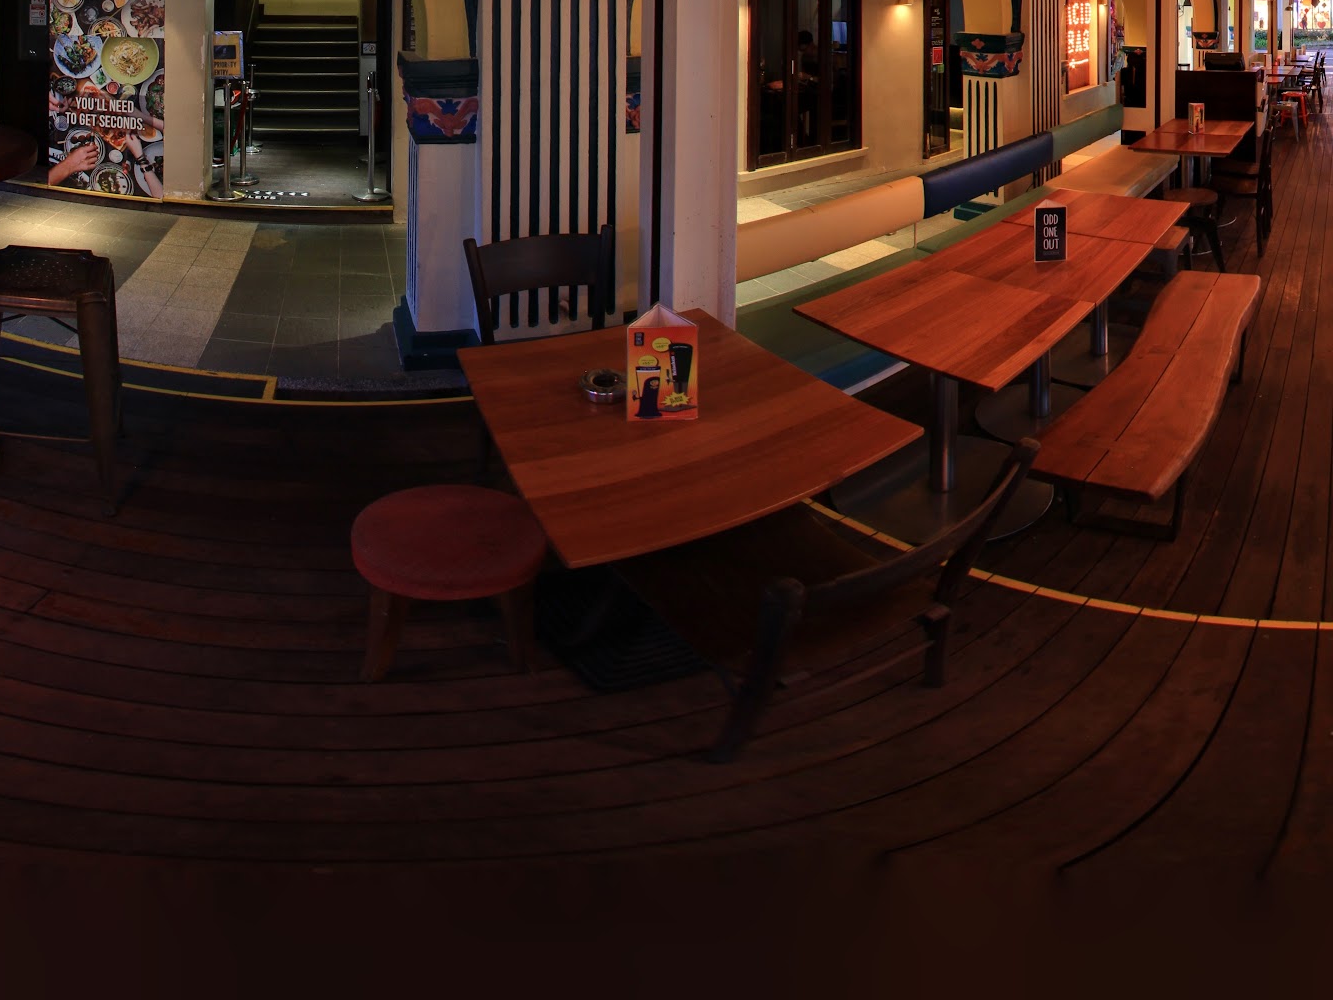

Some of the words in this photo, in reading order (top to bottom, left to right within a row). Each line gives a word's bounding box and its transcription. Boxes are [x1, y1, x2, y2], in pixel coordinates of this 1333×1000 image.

[75, 96, 108, 112] YOU'LL
[109, 99, 134, 113] NEED
[65, 111, 77, 125] TO
[79, 113, 97, 127] GET
[99, 115, 146, 131] SECONDS.
[1043, 213, 1059, 225] ODD
[1043, 226, 1058, 238] ONE
[1043, 238, 1059, 250] OUT
